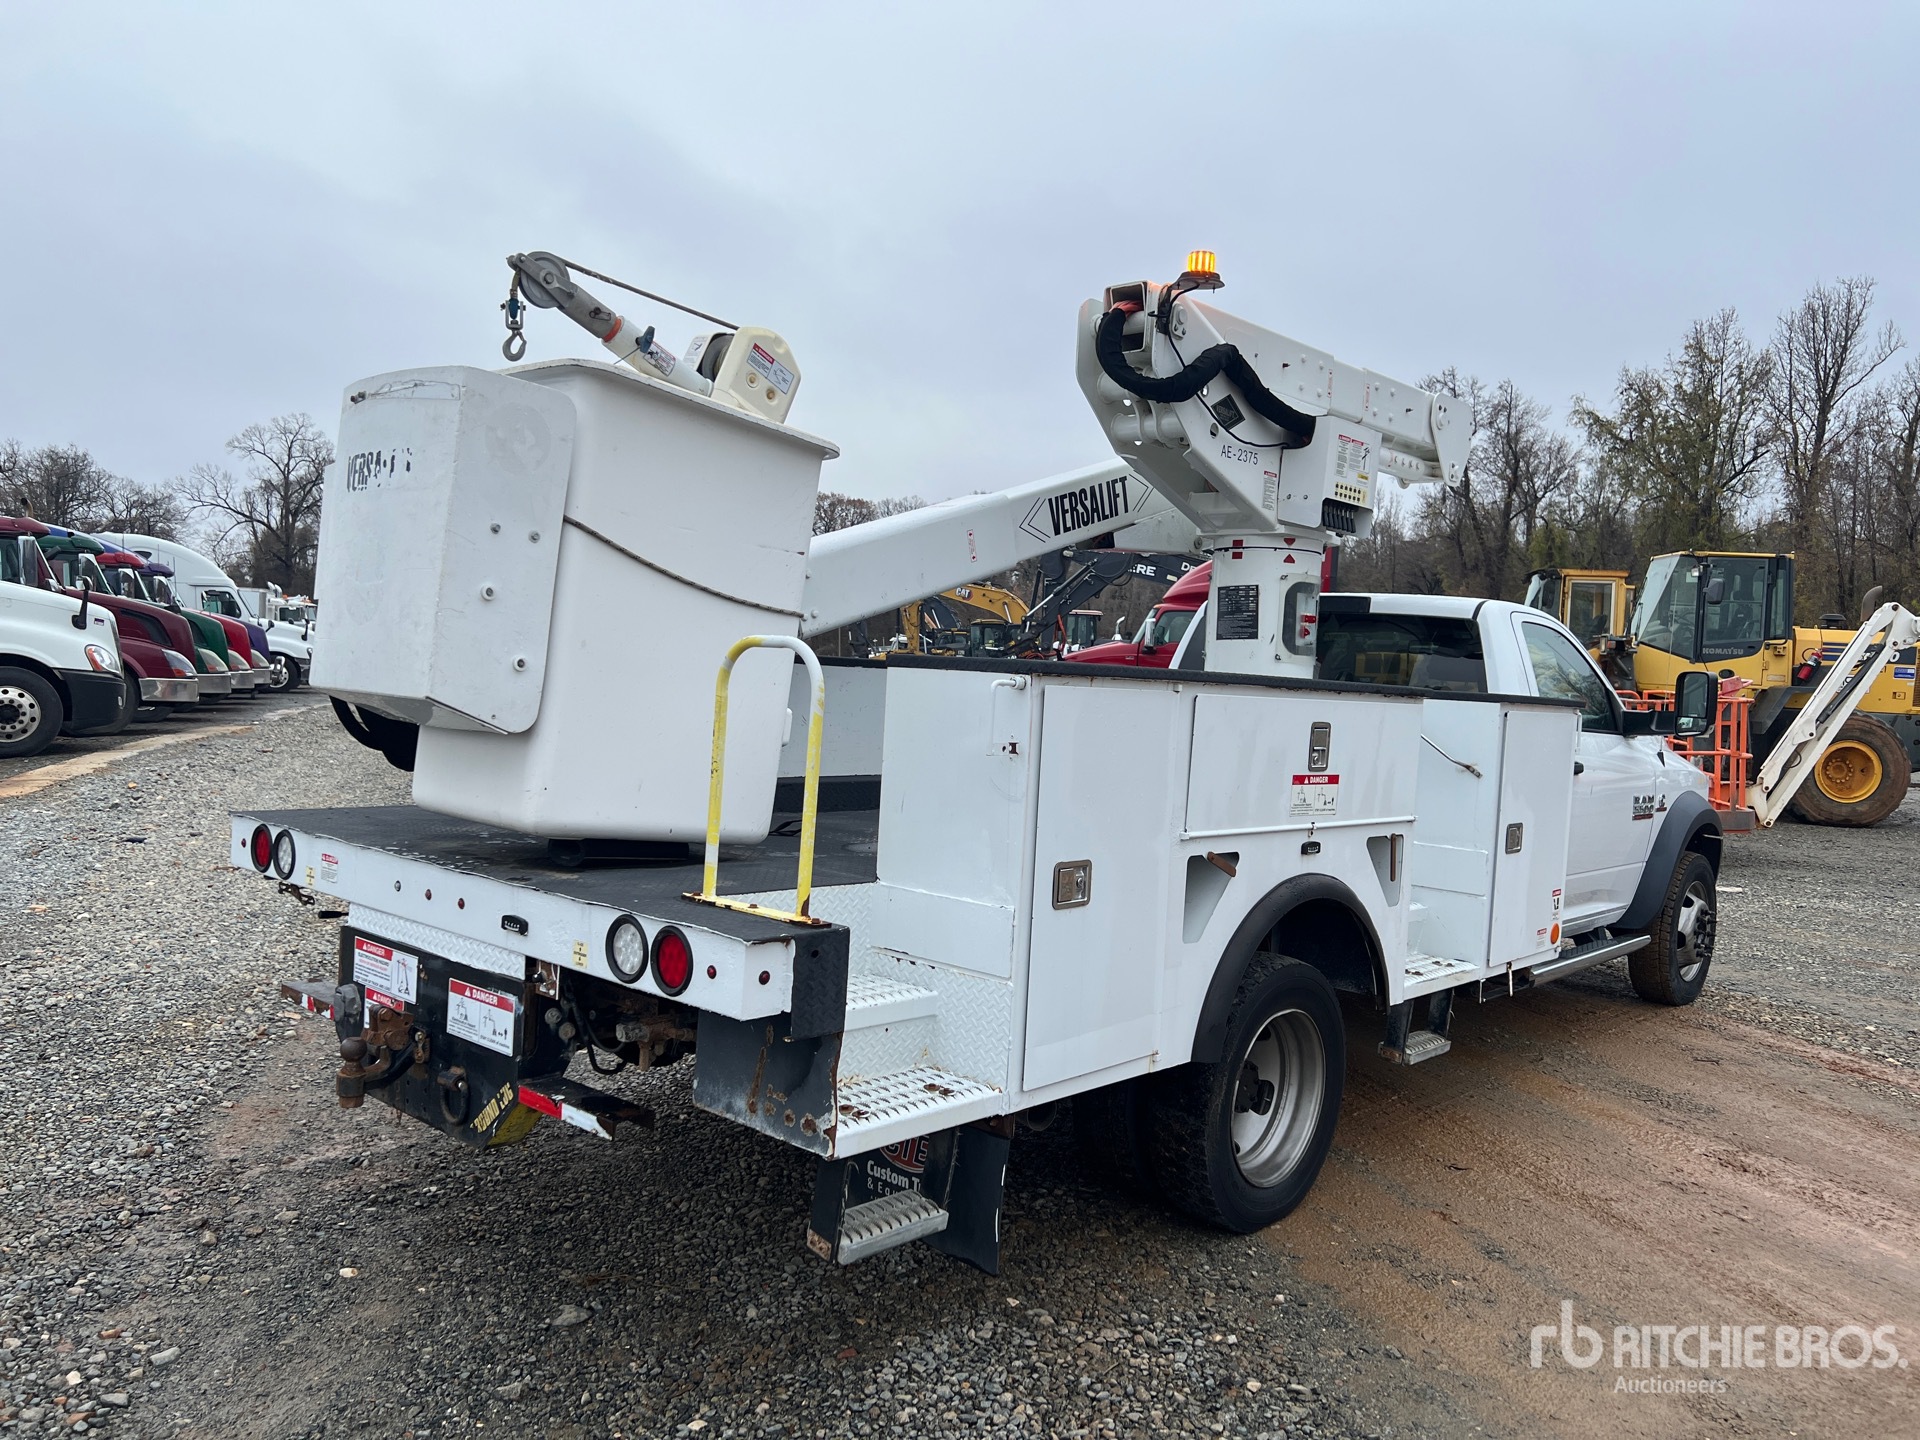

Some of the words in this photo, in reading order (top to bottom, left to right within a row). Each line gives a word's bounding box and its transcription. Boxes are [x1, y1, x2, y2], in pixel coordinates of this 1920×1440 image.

[1221, 444, 1259, 466] AE-2375
[1047, 475, 1129, 536] VERSALIFT
[955, 587, 970, 598] CAT
[1702, 646, 1744, 655] KOMATSU
[1632, 795, 1655, 805] RAM
[367, 944, 386, 957] DANGER
[472, 990, 498, 1006] DANGER
[867, 1159, 909, 1189] Custom
[867, 1177, 874, 1190] &
